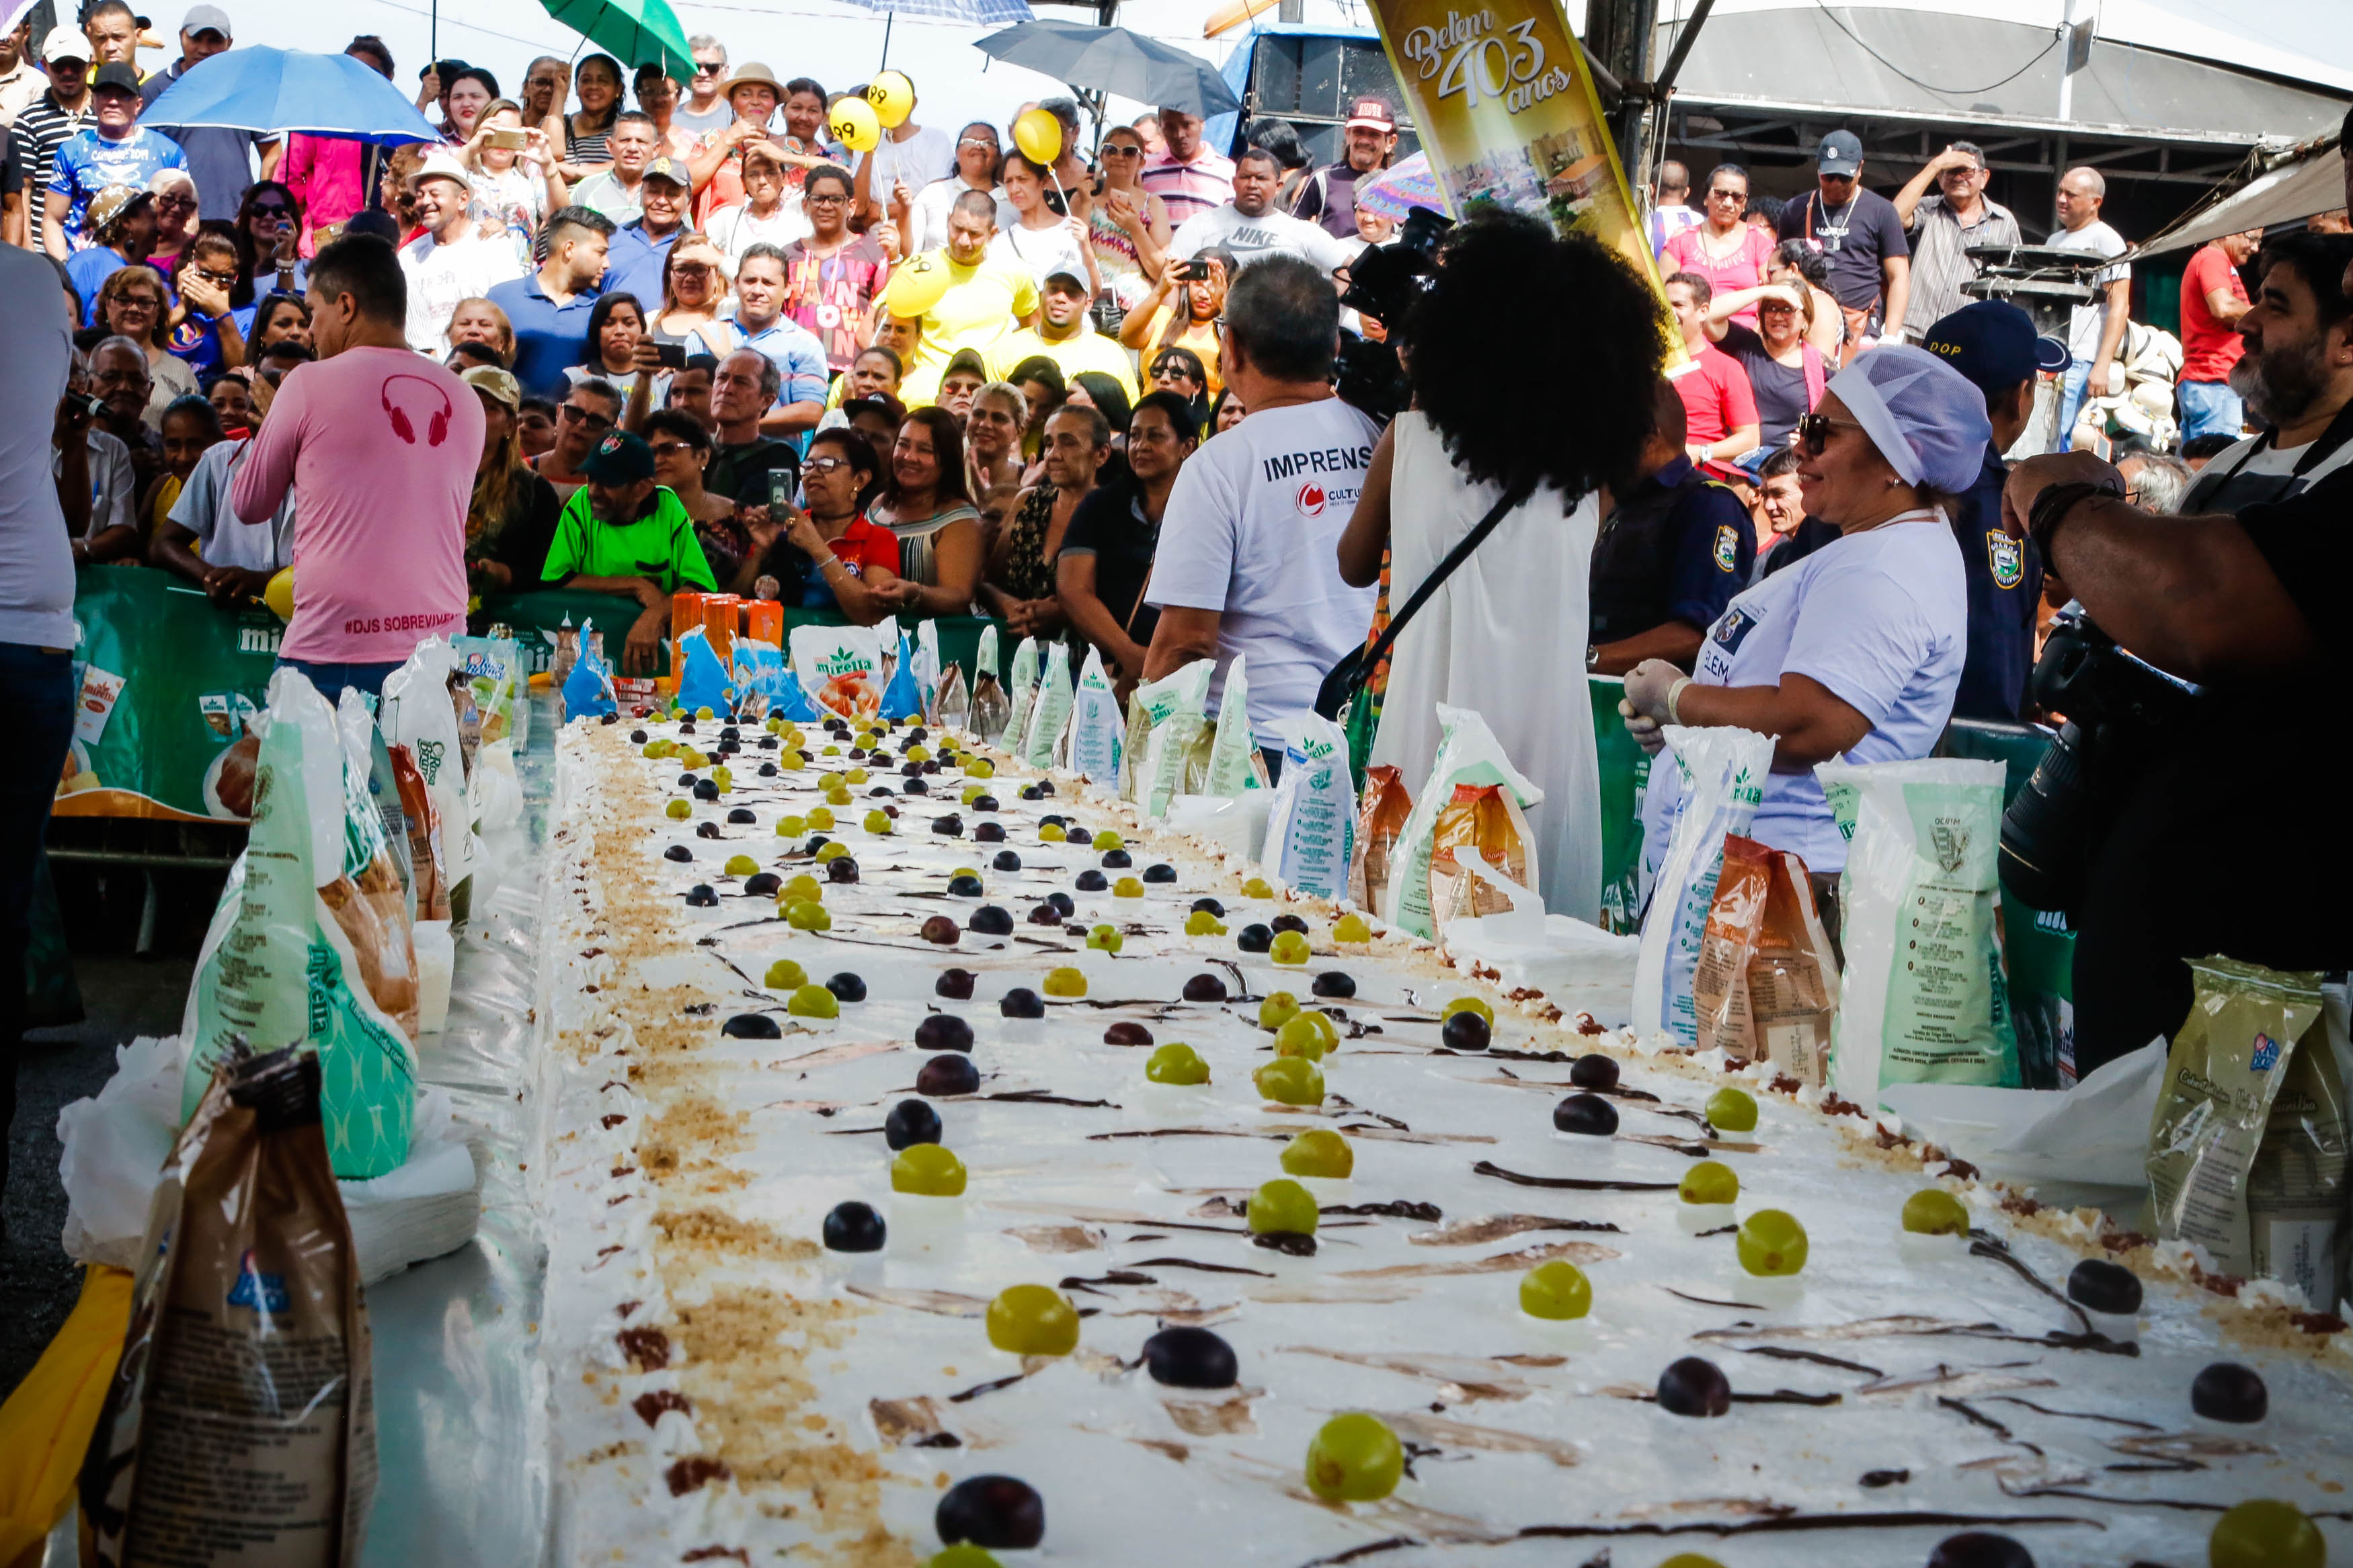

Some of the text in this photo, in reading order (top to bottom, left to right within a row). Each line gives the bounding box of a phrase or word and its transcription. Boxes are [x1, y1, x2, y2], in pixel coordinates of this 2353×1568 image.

[1404, 9, 1494, 79] Belém
[1438, 17, 1545, 108] 403
[869, 85, 887, 104] 99
[1507, 66, 1571, 114] anos
[833, 122, 855, 140] 99
[1232, 226, 1279, 247] NIKE
[1929, 341, 1962, 356] DOP
[1263, 446, 1373, 483] IMPRENS
[345, 612, 458, 634] #DJS SOBREVIVE
[816, 659, 873, 675] mirella
[1934, 817, 1960, 826] OCRIM
[310, 945, 331, 1036] mirella
